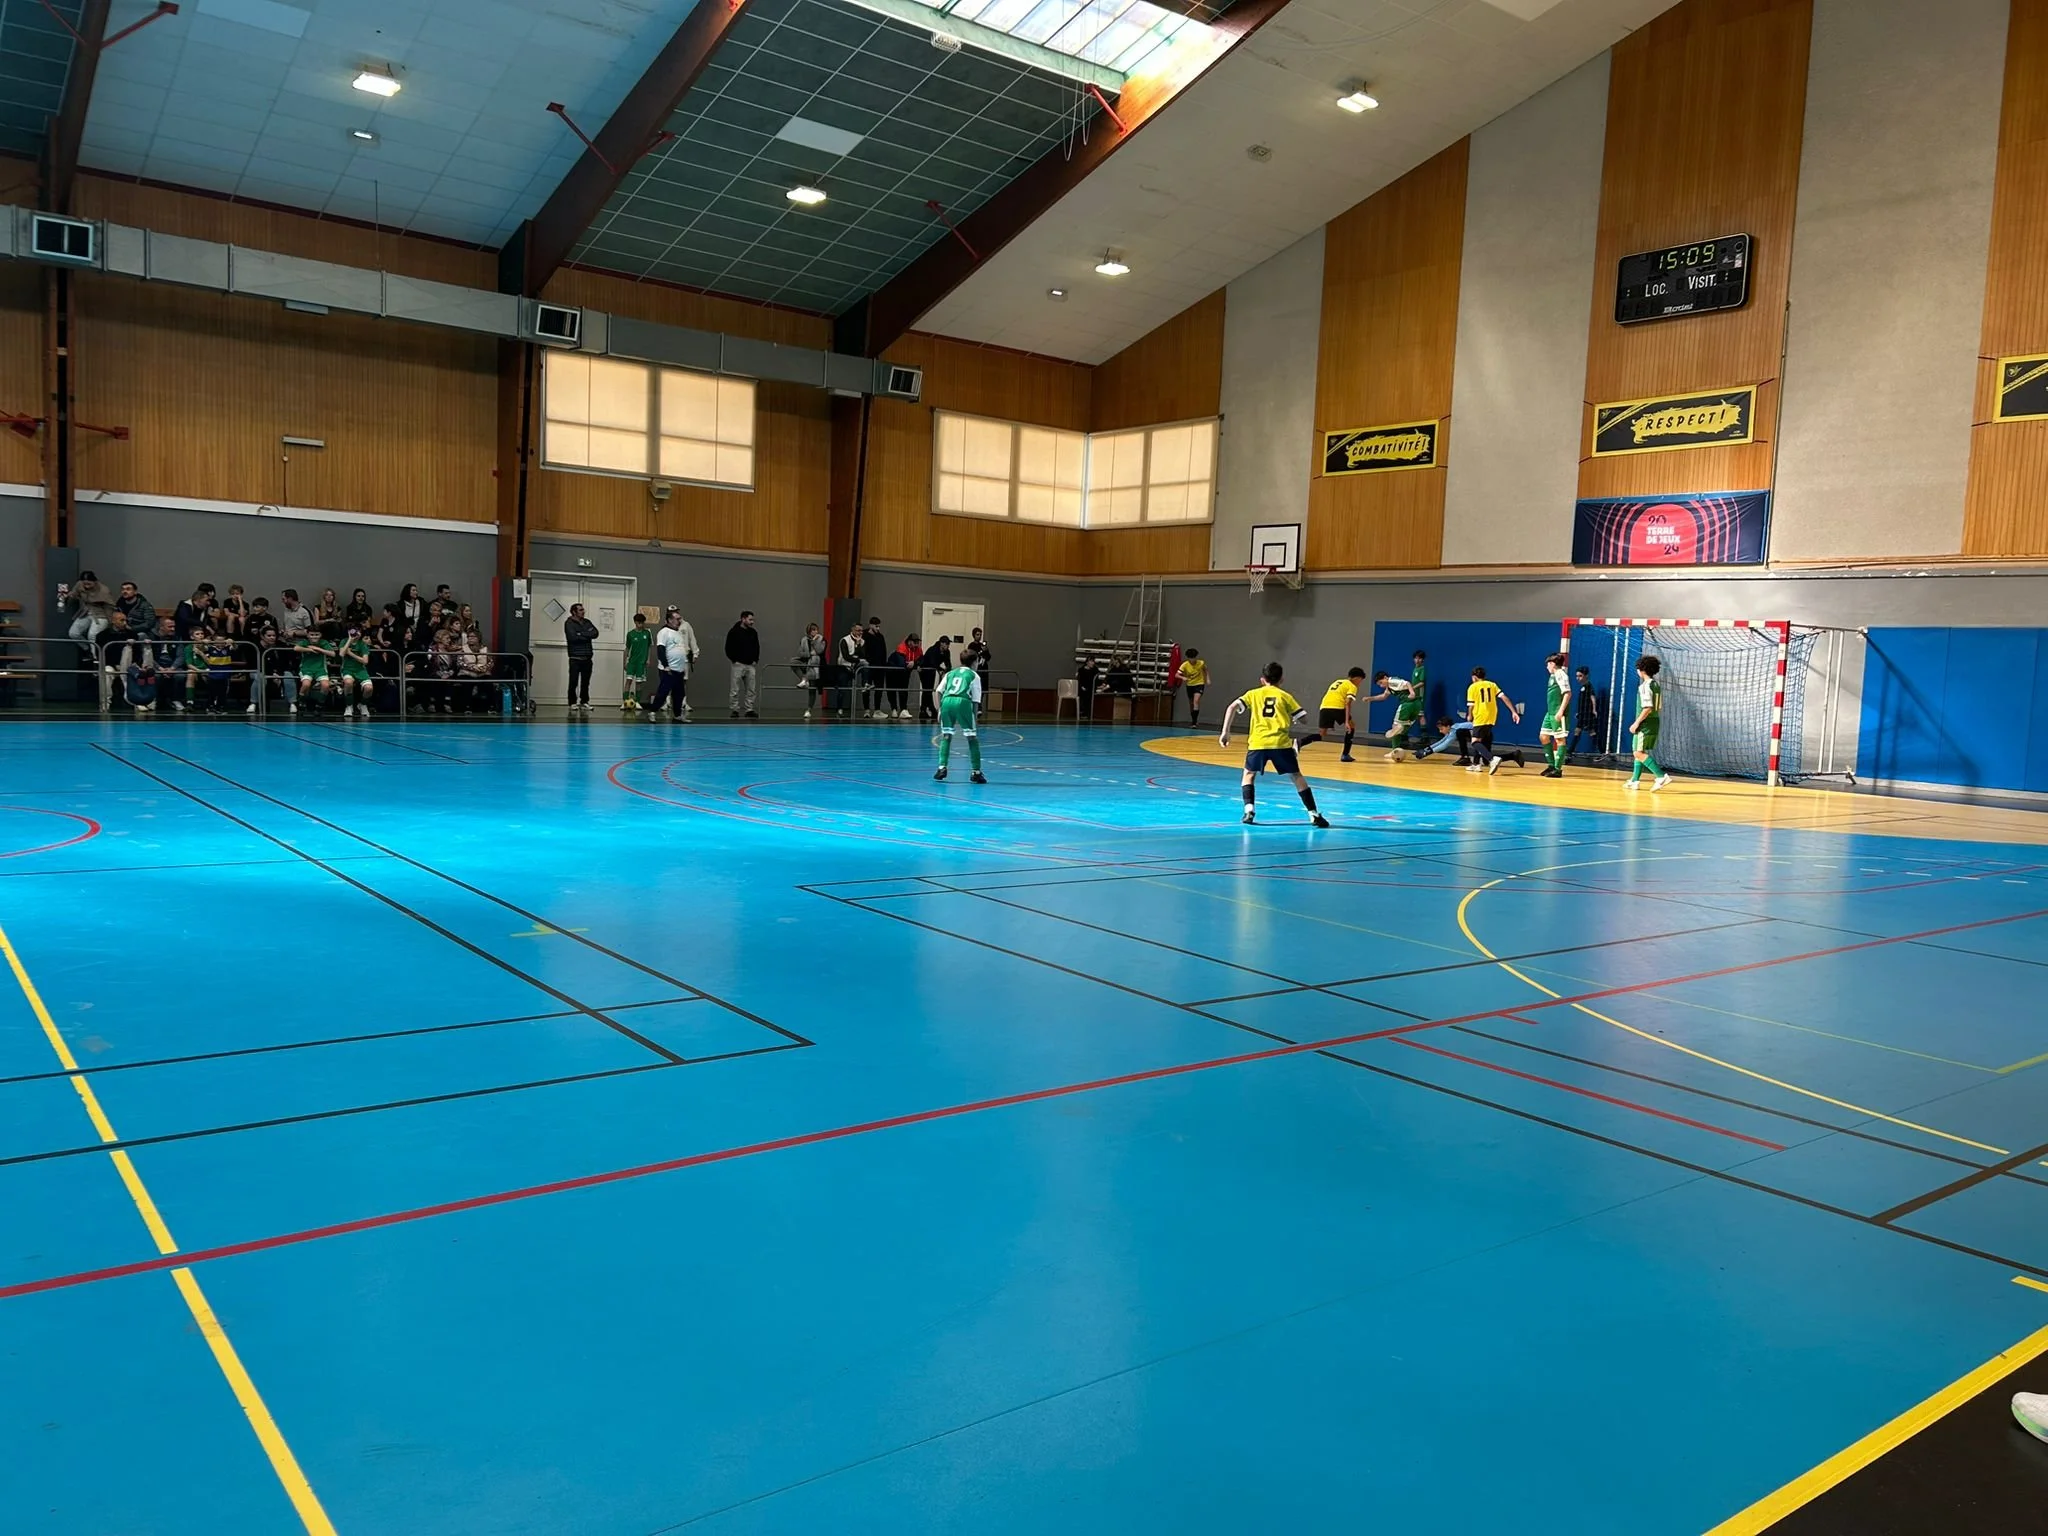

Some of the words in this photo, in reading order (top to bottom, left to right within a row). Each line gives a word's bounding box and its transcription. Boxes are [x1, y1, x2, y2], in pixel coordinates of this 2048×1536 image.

[1659, 244, 1715, 270] 15:09
[1645, 282, 1669, 298] LOC.
[1688, 274, 1717, 290] VISIT.
[1648, 514, 1667, 526] 20
[1647, 525, 1675, 536] TERRE
[1646, 535, 1658, 545] DE
[1658, 534, 1681, 544] JEUX
[1664, 544, 1679, 556] 24
[949, 677, 963, 695] 9
[1480, 687, 1491, 703] 11
[1262, 697, 1277, 718] 8
